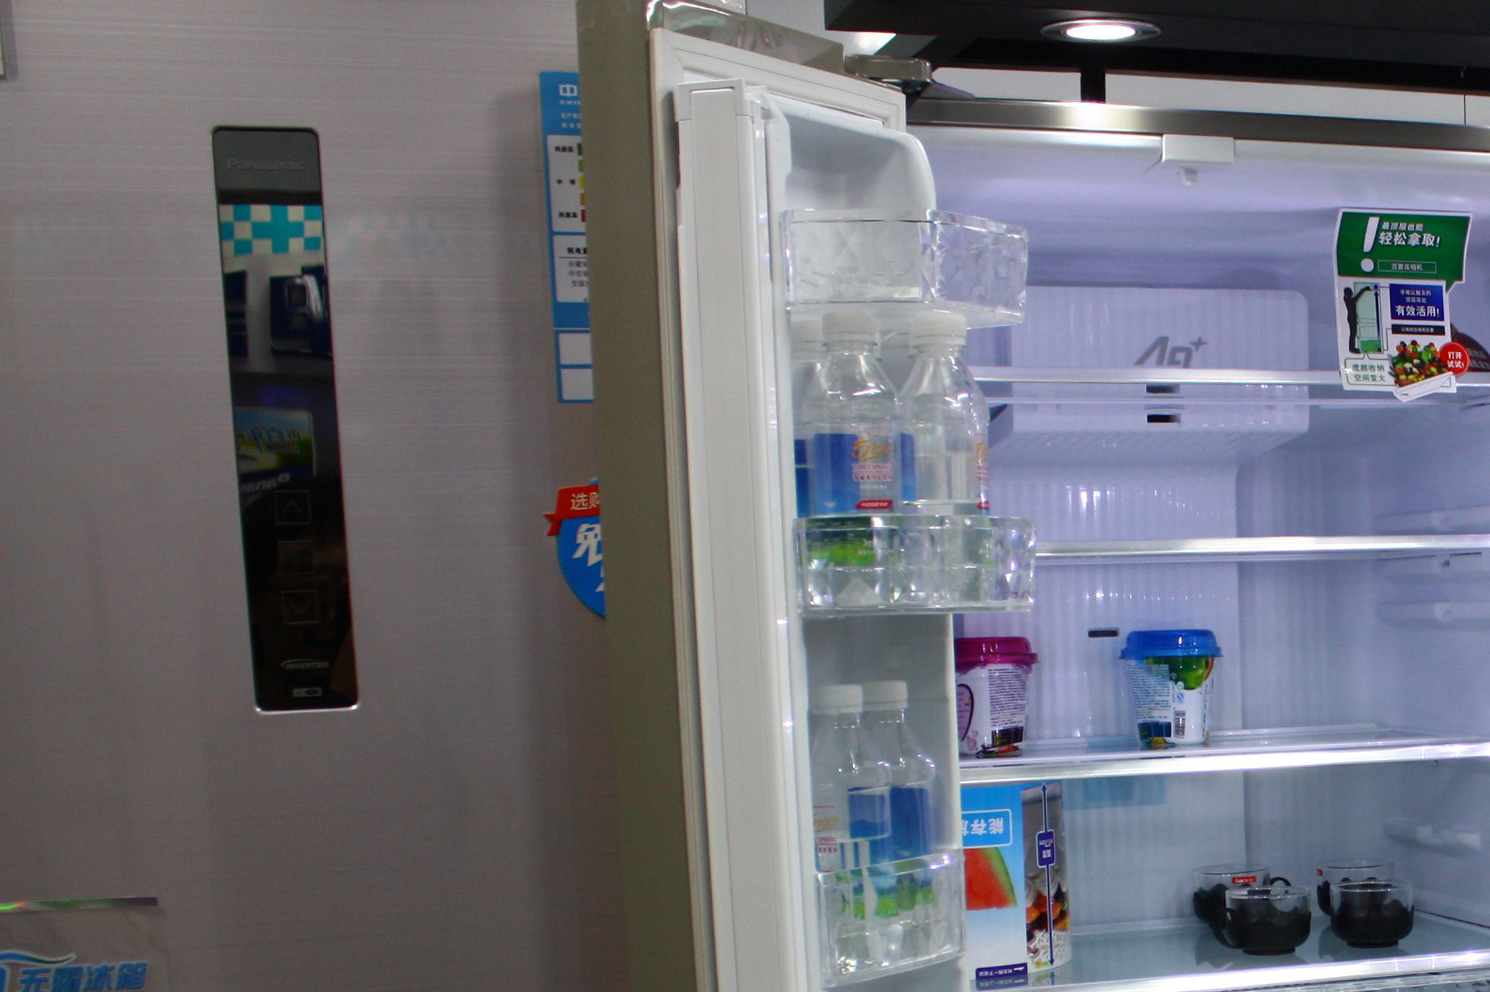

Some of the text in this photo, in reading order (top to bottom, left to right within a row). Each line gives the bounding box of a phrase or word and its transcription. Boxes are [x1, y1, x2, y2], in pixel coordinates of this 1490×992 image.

[1379, 231, 1440, 247] 轻松拿取!
[1395, 305, 1440, 317] 有效活用!
